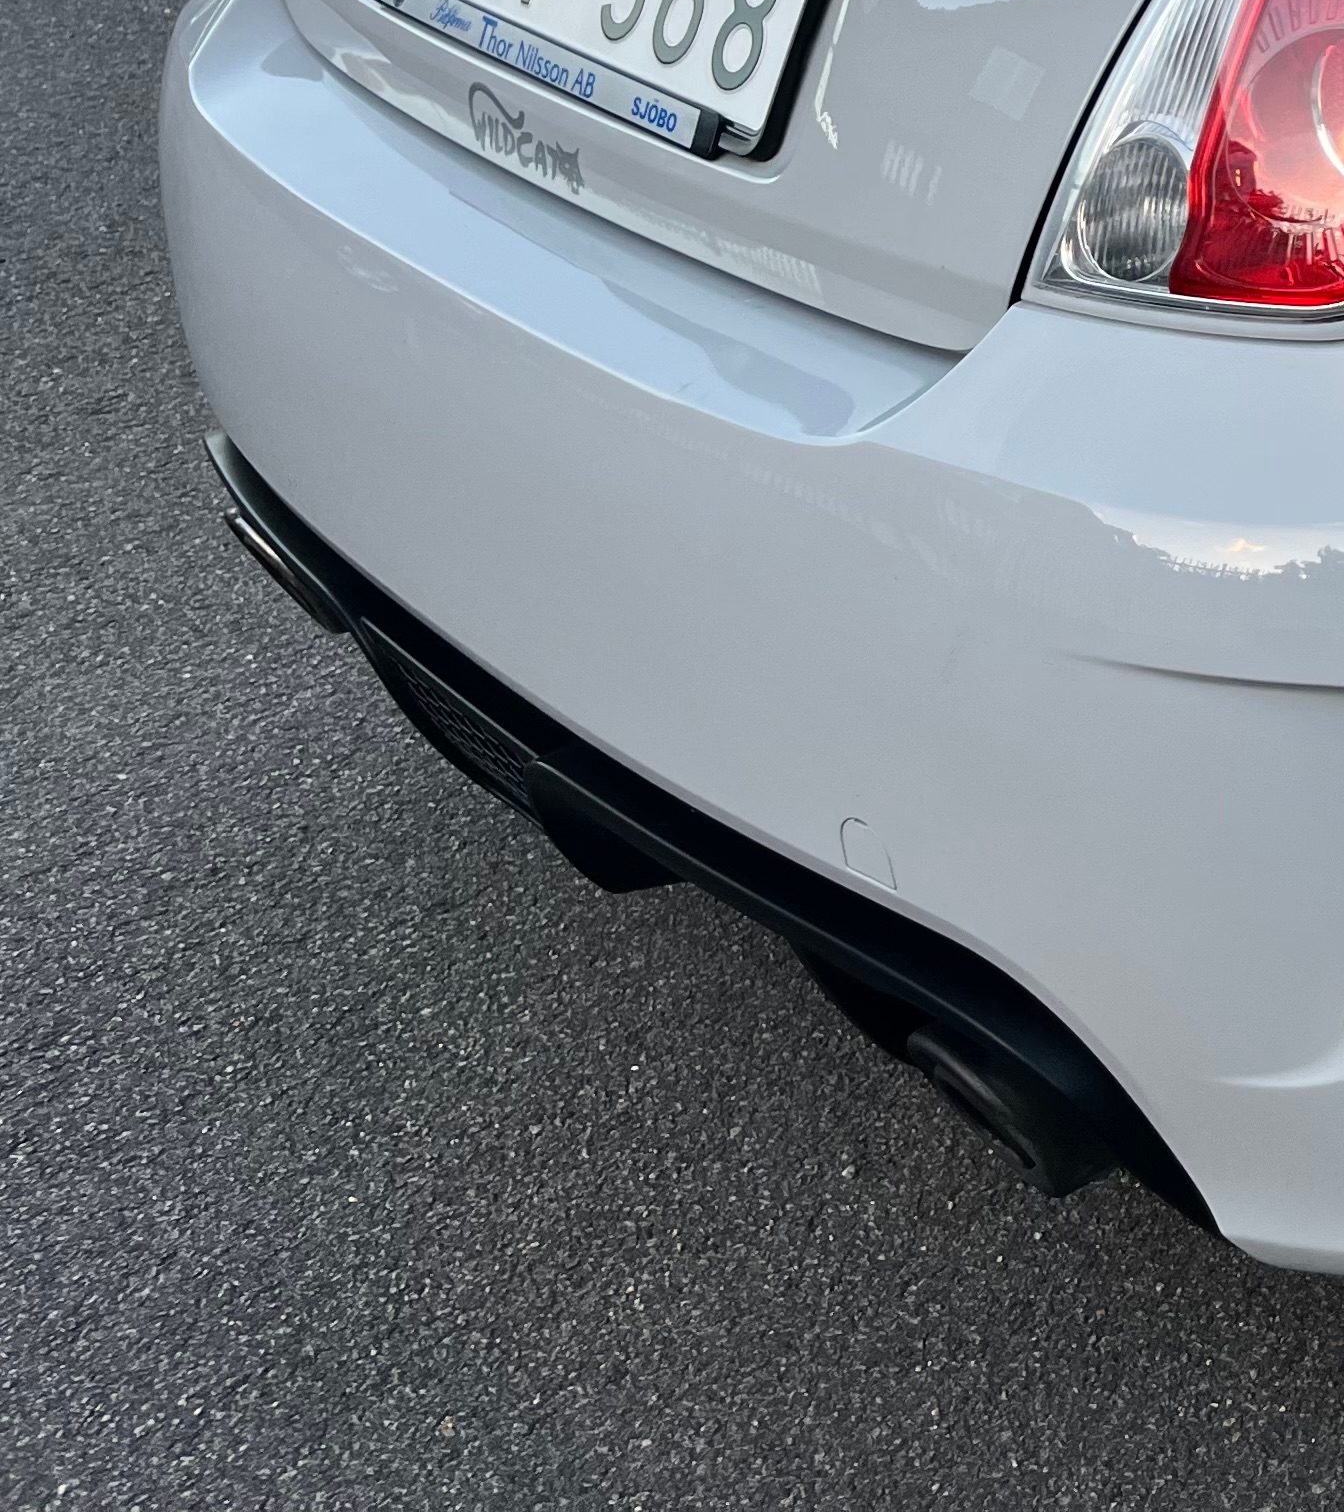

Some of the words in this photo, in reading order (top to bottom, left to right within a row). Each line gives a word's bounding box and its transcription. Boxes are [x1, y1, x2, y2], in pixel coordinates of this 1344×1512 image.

[477, 16, 513, 58] Thor
[515, 39, 569, 89] Nilsson
[571, 68, 597, 99] AB
[631, 96, 678, 133] SJÖBO
[469, 82, 561, 180] WILDCAT
